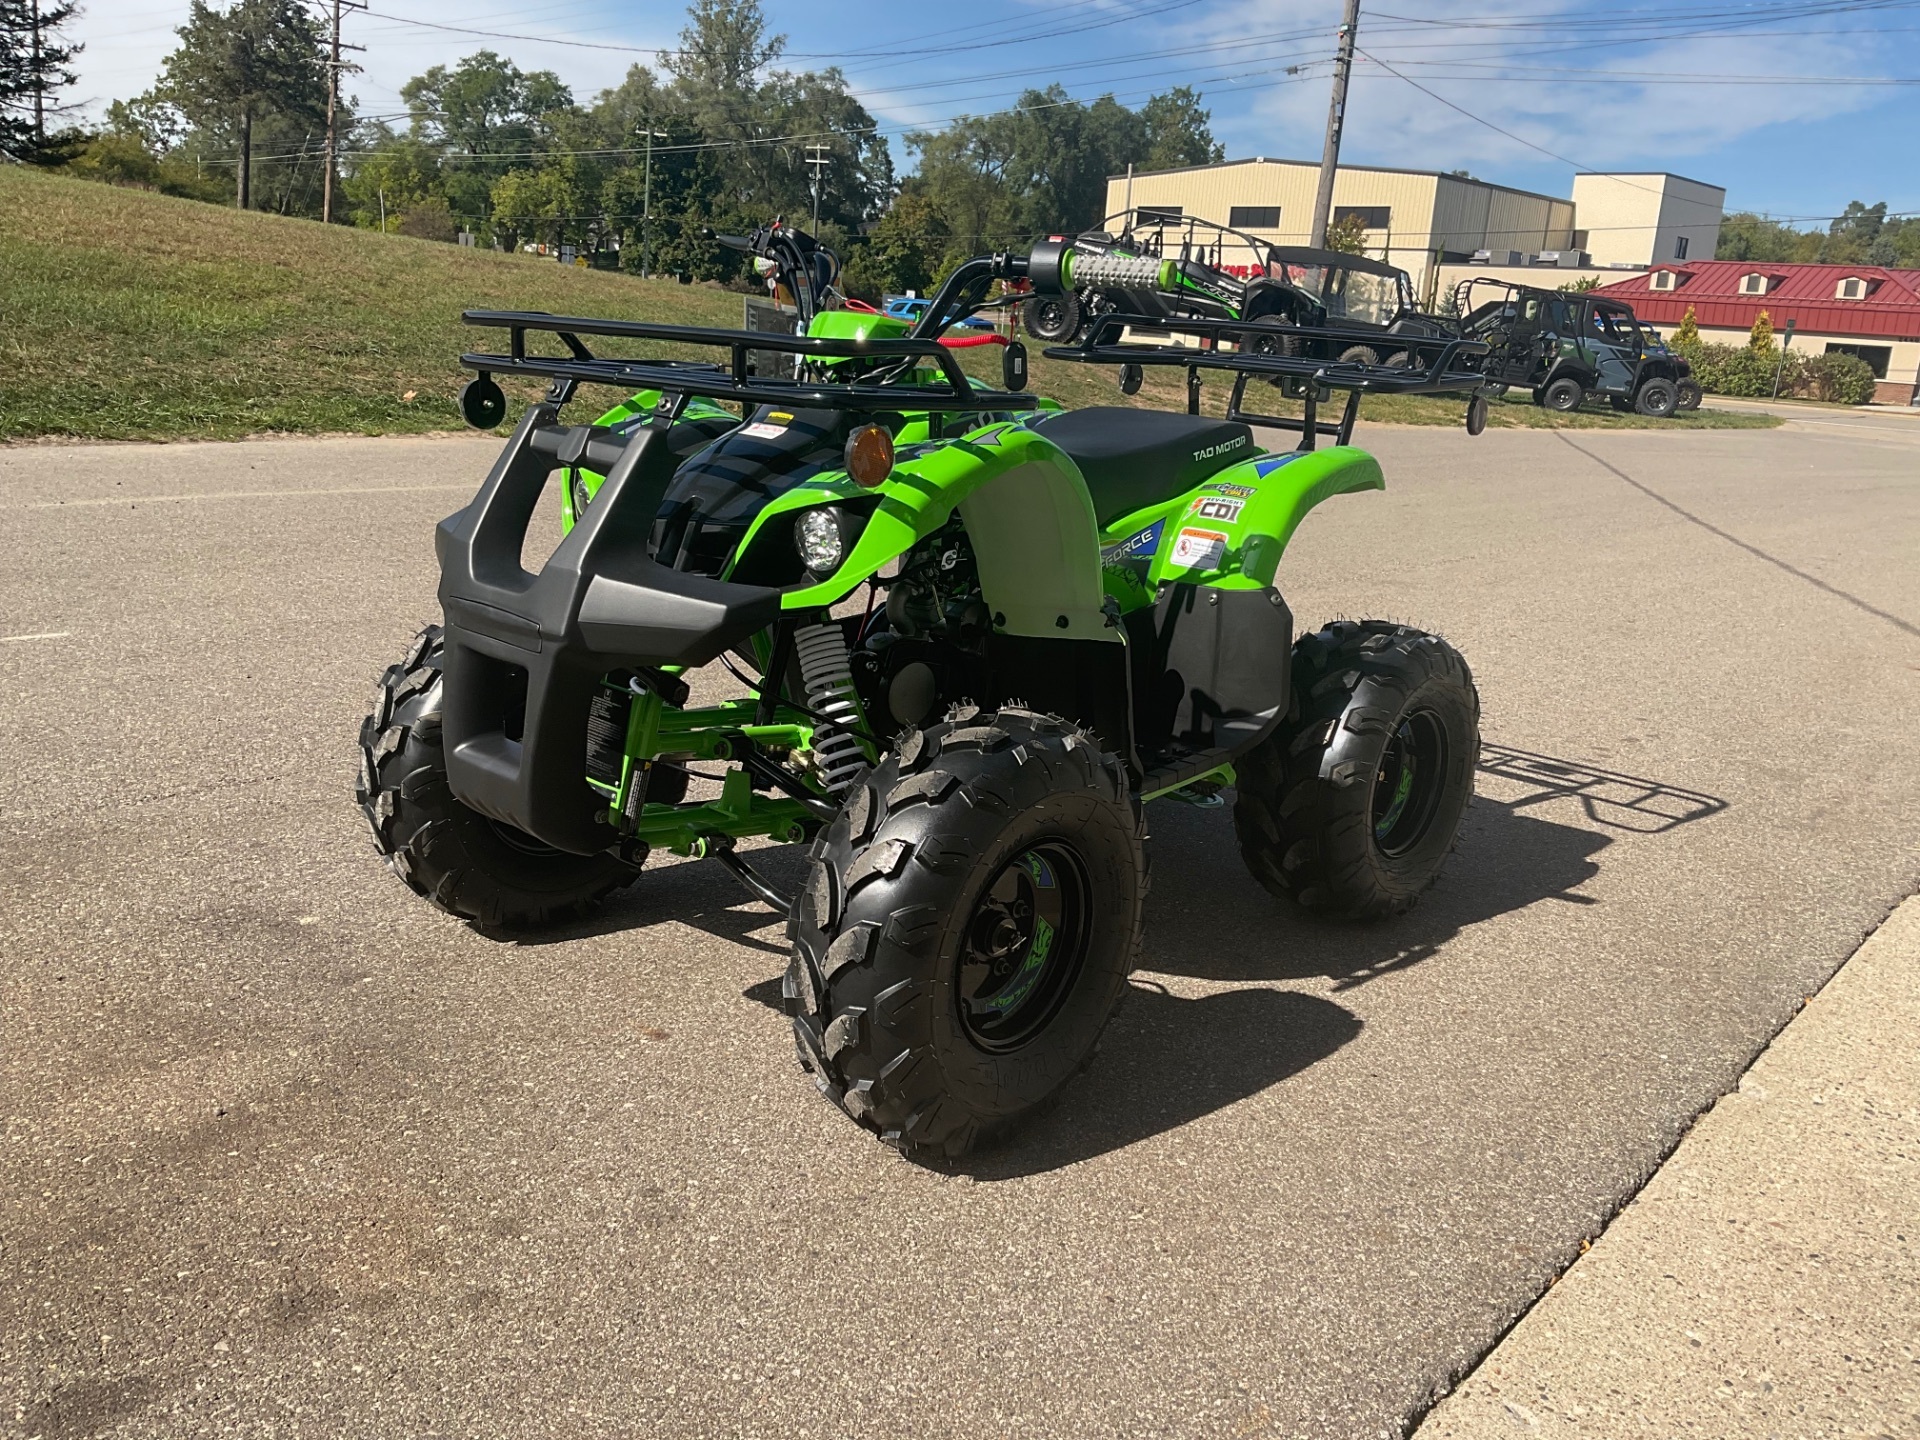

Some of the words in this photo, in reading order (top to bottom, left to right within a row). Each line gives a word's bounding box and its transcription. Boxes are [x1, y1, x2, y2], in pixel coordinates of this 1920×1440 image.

[1193, 446, 1214, 462] TAO
[1215, 435, 1246, 455] MOTOR
[1199, 502, 1242, 522] CDI
